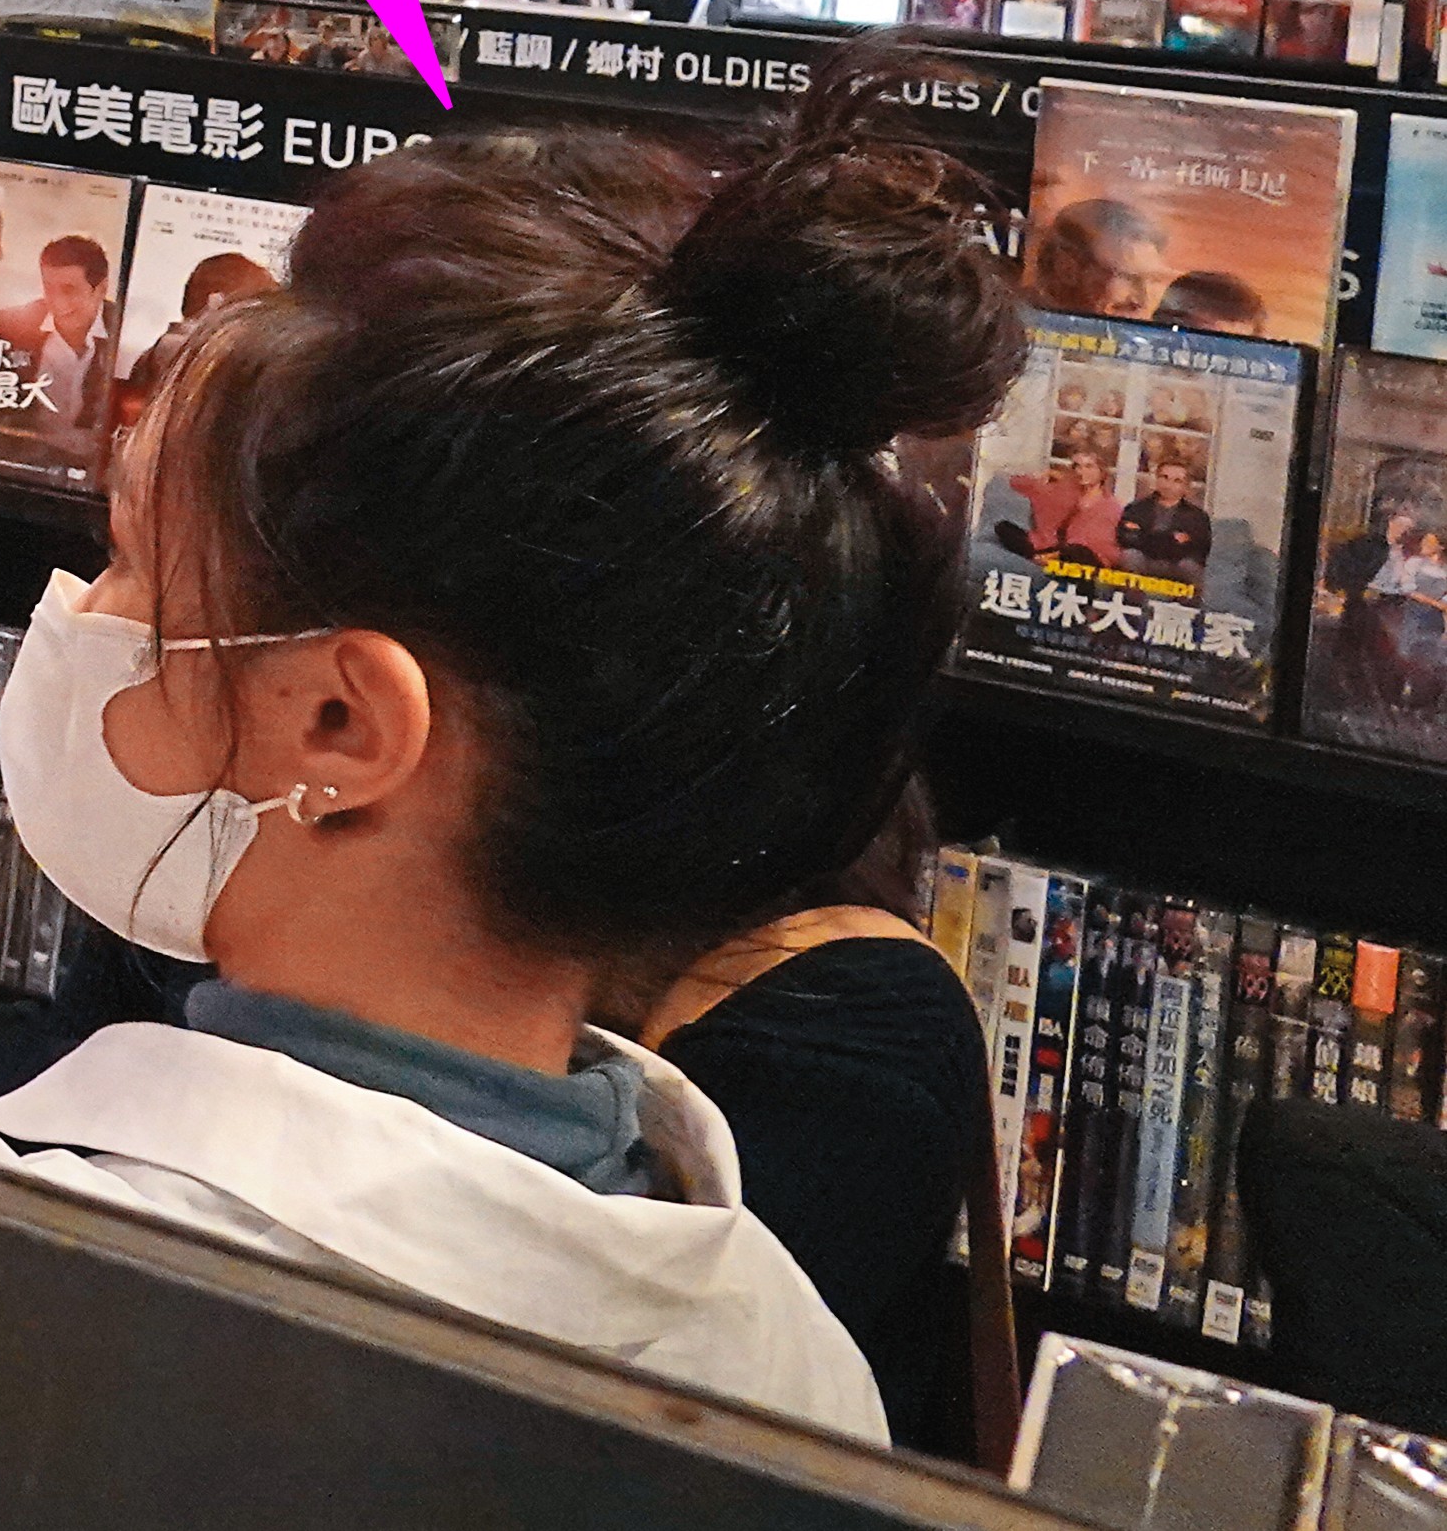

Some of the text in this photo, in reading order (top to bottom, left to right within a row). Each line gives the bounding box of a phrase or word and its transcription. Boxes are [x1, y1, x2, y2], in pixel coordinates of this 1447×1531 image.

[674, 50, 812, 93] OLDIES
[12, 74, 264, 162] 歐美電影
[979, 568, 1255, 659] 退休大贏家
